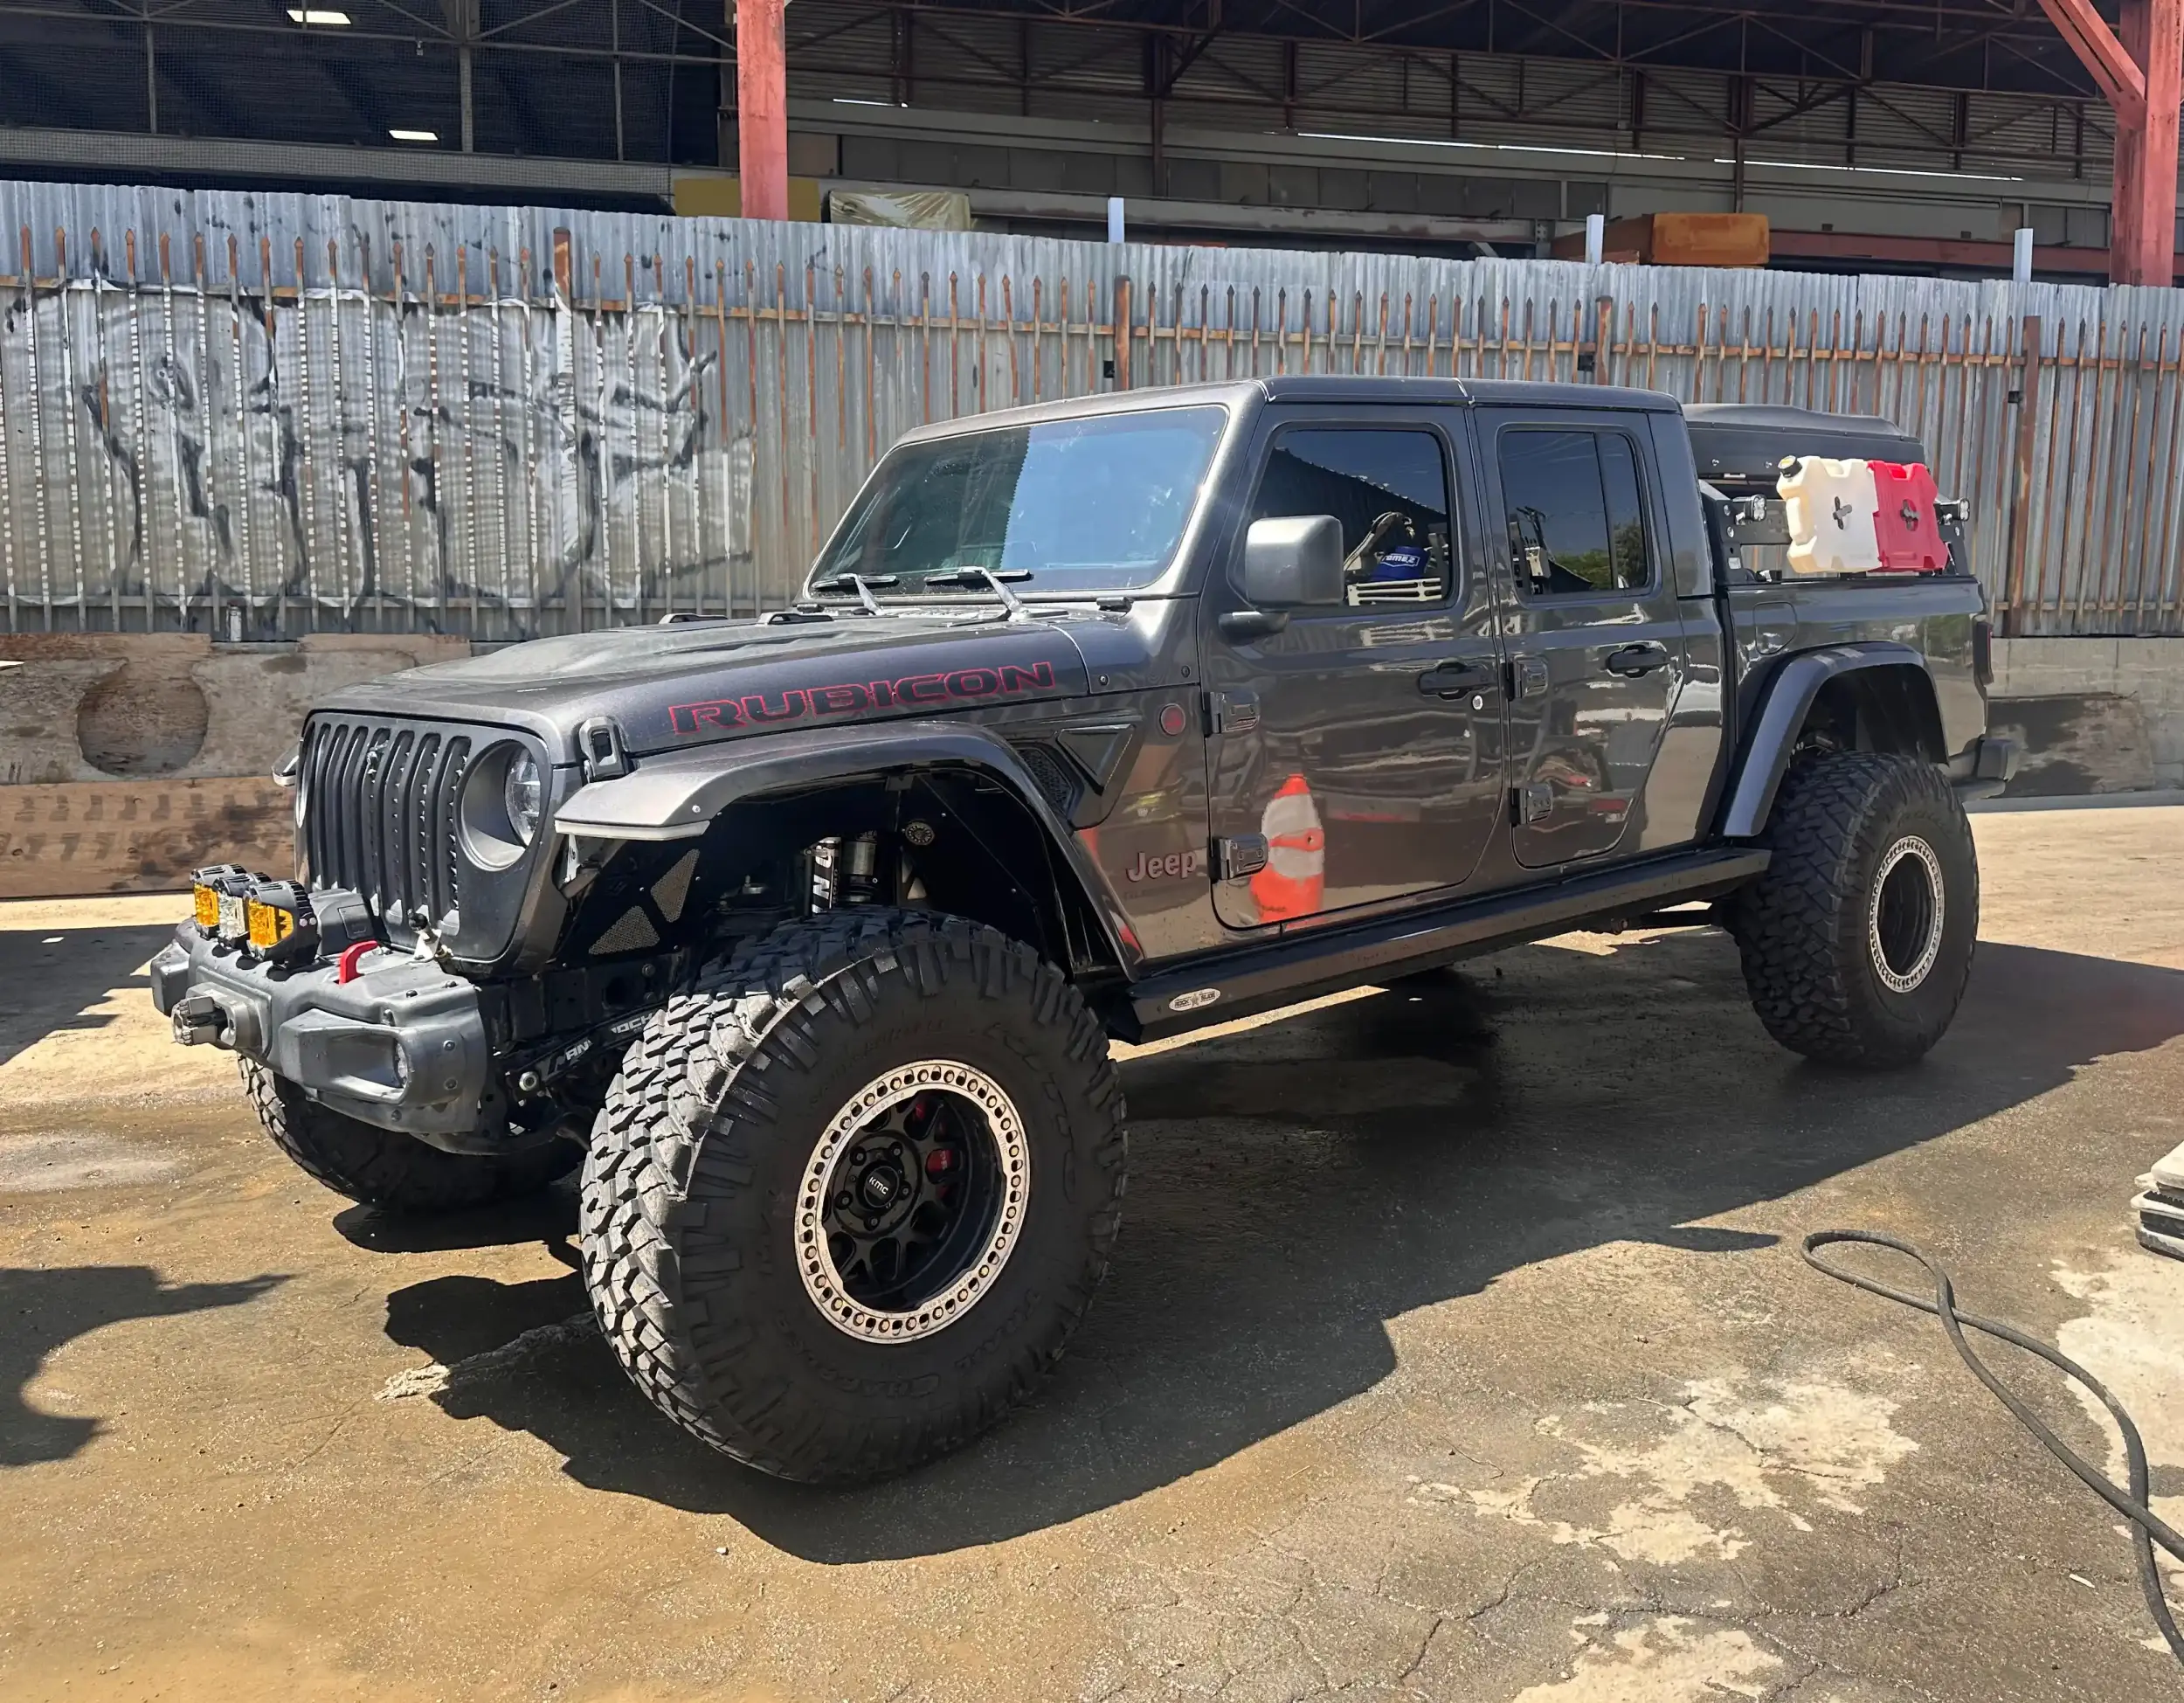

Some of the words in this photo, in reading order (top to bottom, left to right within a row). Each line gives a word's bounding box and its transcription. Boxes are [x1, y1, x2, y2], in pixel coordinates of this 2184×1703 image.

[667, 661, 1055, 735] RUBICON
[1126, 850, 1198, 883] Jeep
[868, 1176, 889, 1195] KMC
